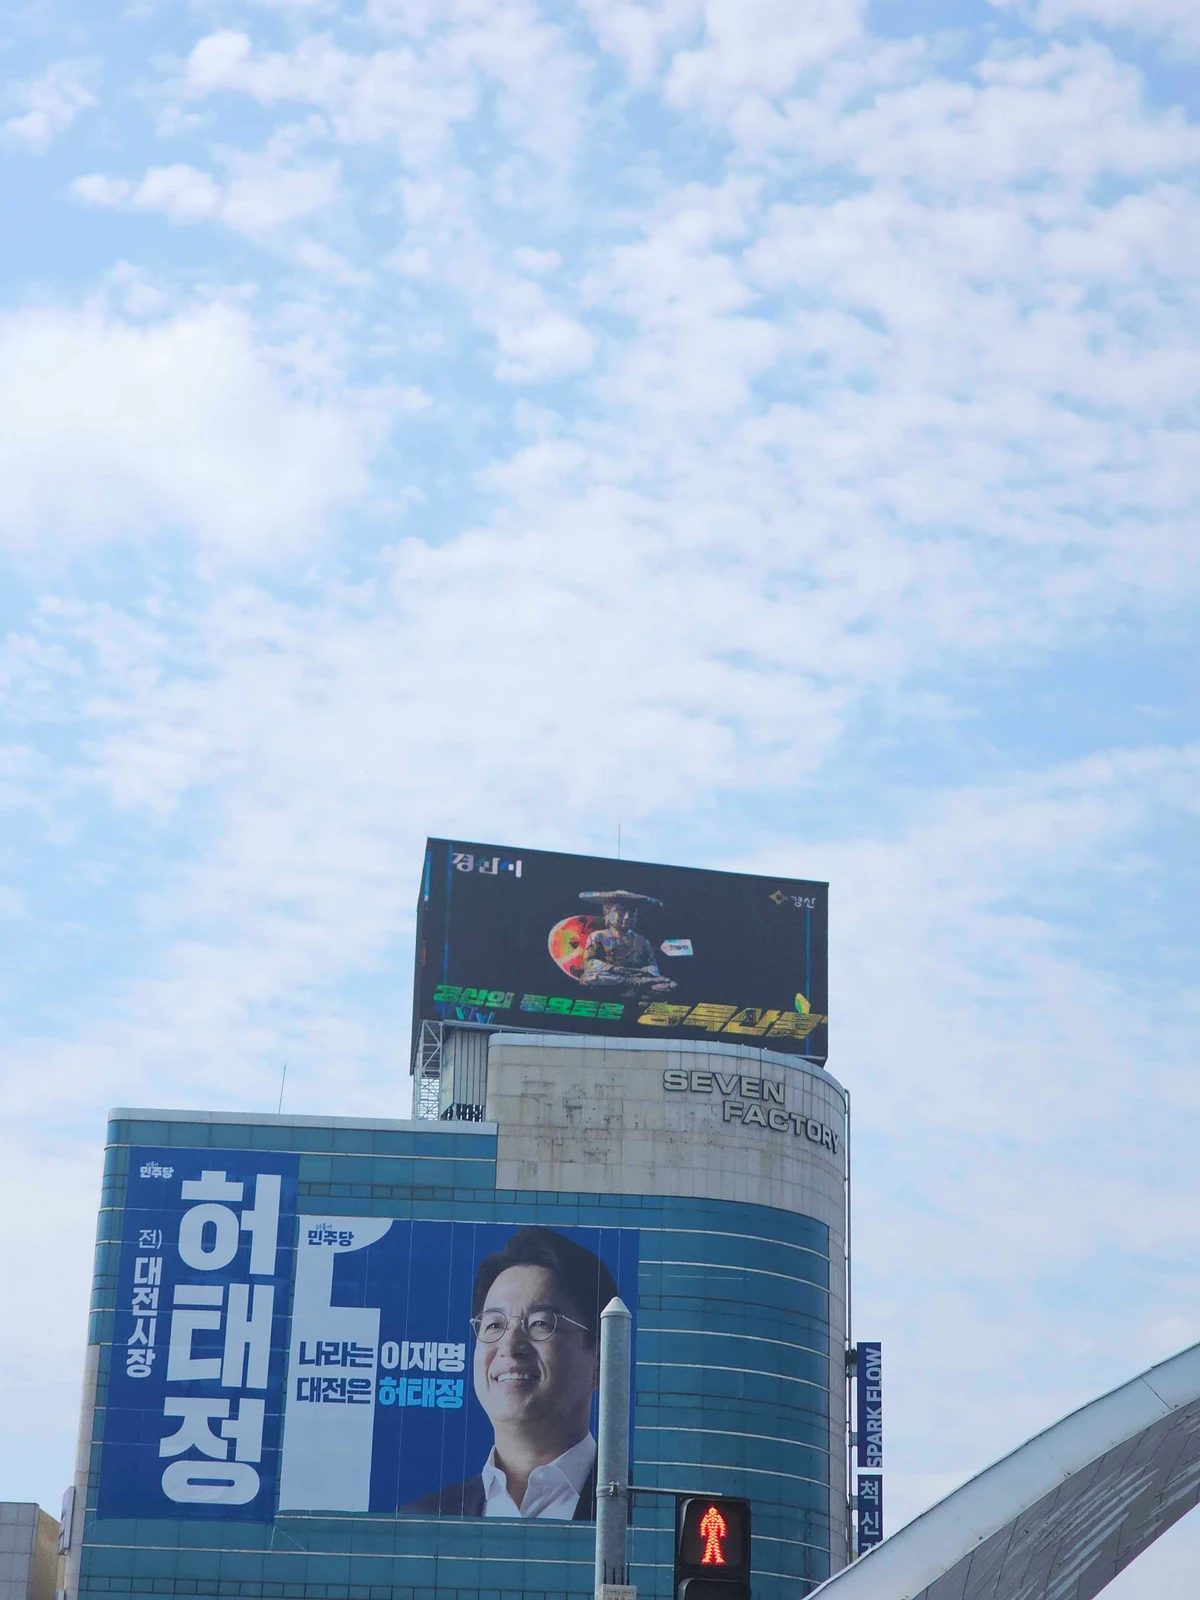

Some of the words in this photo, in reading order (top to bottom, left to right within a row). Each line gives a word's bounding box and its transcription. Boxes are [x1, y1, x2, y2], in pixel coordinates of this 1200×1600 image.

[790, 895, 816, 909] 경산
[663, 1069, 786, 1104] SEVEN
[723, 1100, 841, 1154] FACTORY
[140, 1166, 175, 1179] 민주당
[138, 1229, 163, 1249] 전)
[308, 1230, 355, 1247] 민주당
[126, 1256, 163, 1378] 대전시장
[158, 1170, 282, 1505] 허태정
[298, 1340, 374, 1368] 나라는
[380, 1340, 466, 1372] 이재명
[865, 1347, 882, 1402] FLOW
[296, 1376, 372, 1405] 대전은
[378, 1376, 464, 1409] 허태정
[866, 1406, 882, 1468] SPARK
